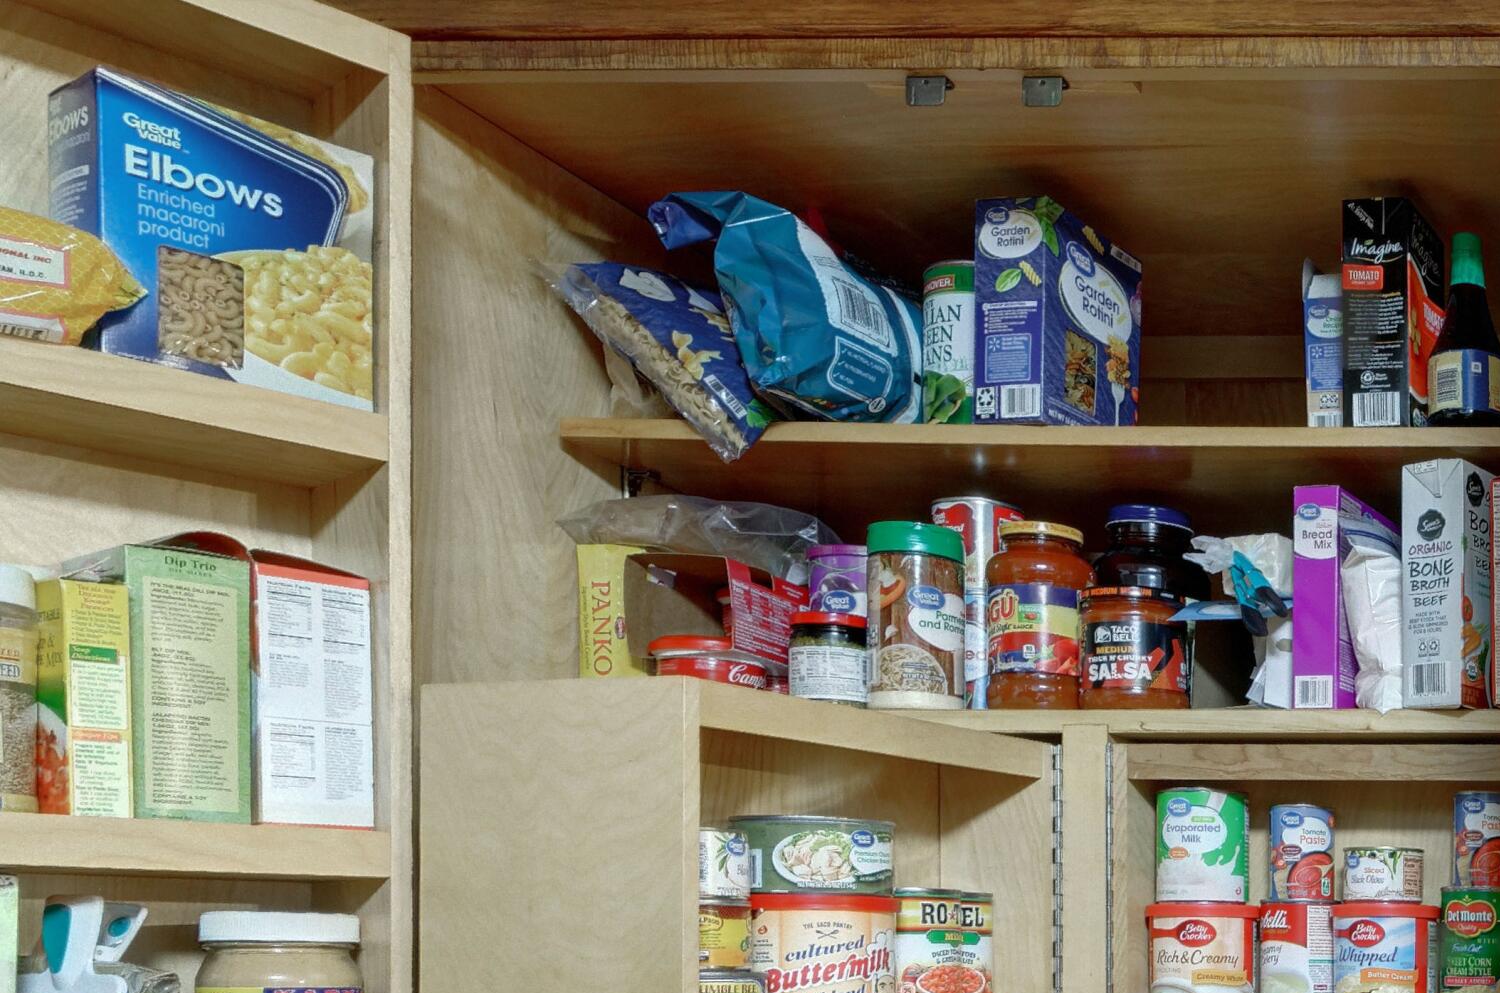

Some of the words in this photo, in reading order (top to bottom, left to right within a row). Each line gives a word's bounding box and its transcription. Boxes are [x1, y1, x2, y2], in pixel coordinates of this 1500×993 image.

[122, 112, 181, 140] Great
[138, 130, 182, 150] Value
[125, 143, 284, 219] Elbows
[137, 183, 215, 218] Enriched
[137, 203, 225, 237] macaroni
[138, 221, 209, 249] product
[991, 226, 1031, 237] Garden
[997, 236, 1024, 247] Rotini
[1351, 237, 1403, 263] Imagine
[1348, 270, 1380, 281] TOMATO
[1075, 275, 1120, 315] Garden
[1082, 299, 1114, 328] Rotini
[1302, 529, 1333, 540] Bread
[1314, 540, 1332, 550] Mix
[1408, 542, 1453, 556] ORGANIC
[164, 554, 185, 569] Dip
[190, 558, 217, 572] Trio
[1408, 559, 1454, 578] BONE
[1410, 577, 1450, 592] BROTH
[1414, 595, 1448, 607] BEEF
[591, 581, 613, 676] PANKO
[919, 619, 941, 628] and
[1111, 625, 1139, 633] TACO
[1096, 646, 1136, 654] MEDIUM
[1089, 662, 1152, 681] SALSA
[1166, 823, 1221, 837] Evaporated
[1181, 834, 1201, 843] Milk
[1300, 835, 1326, 845] Paste
[1448, 910, 1460, 921] Del
[1461, 911, 1492, 922] Monte
[785, 935, 865, 963] cultured
[1339, 946, 1398, 966] Whipped
[1469, 957, 1492, 967] CORN
[1367, 971, 1390, 979] Butter
[1468, 966, 1492, 976] STYLE
